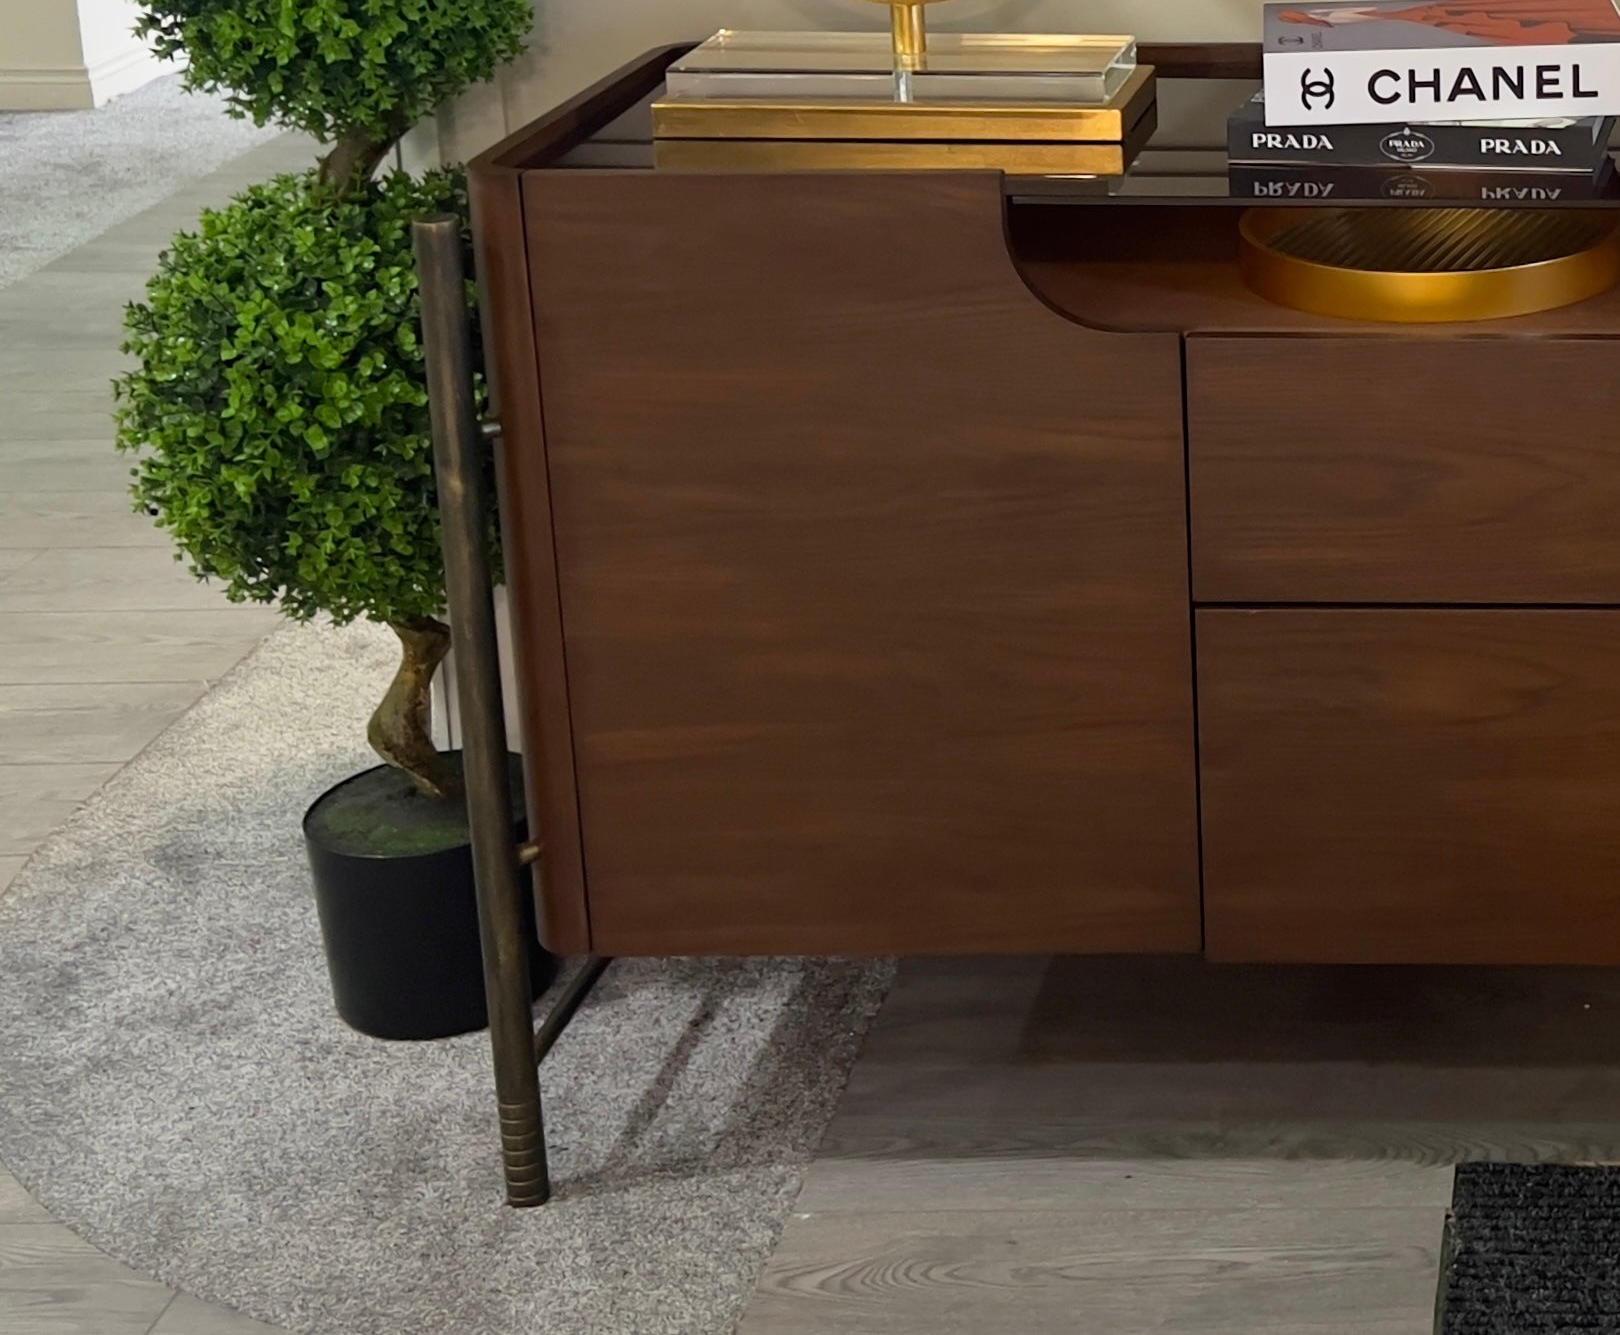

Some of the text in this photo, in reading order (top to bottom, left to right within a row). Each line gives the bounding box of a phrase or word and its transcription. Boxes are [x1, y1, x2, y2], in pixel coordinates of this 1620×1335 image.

[1367, 64, 1599, 104] CHANEL
[1252, 133, 1334, 150] PRADA
[1388, 139, 1425, 148] PRADA
[1480, 138, 1562, 155] PRADA
